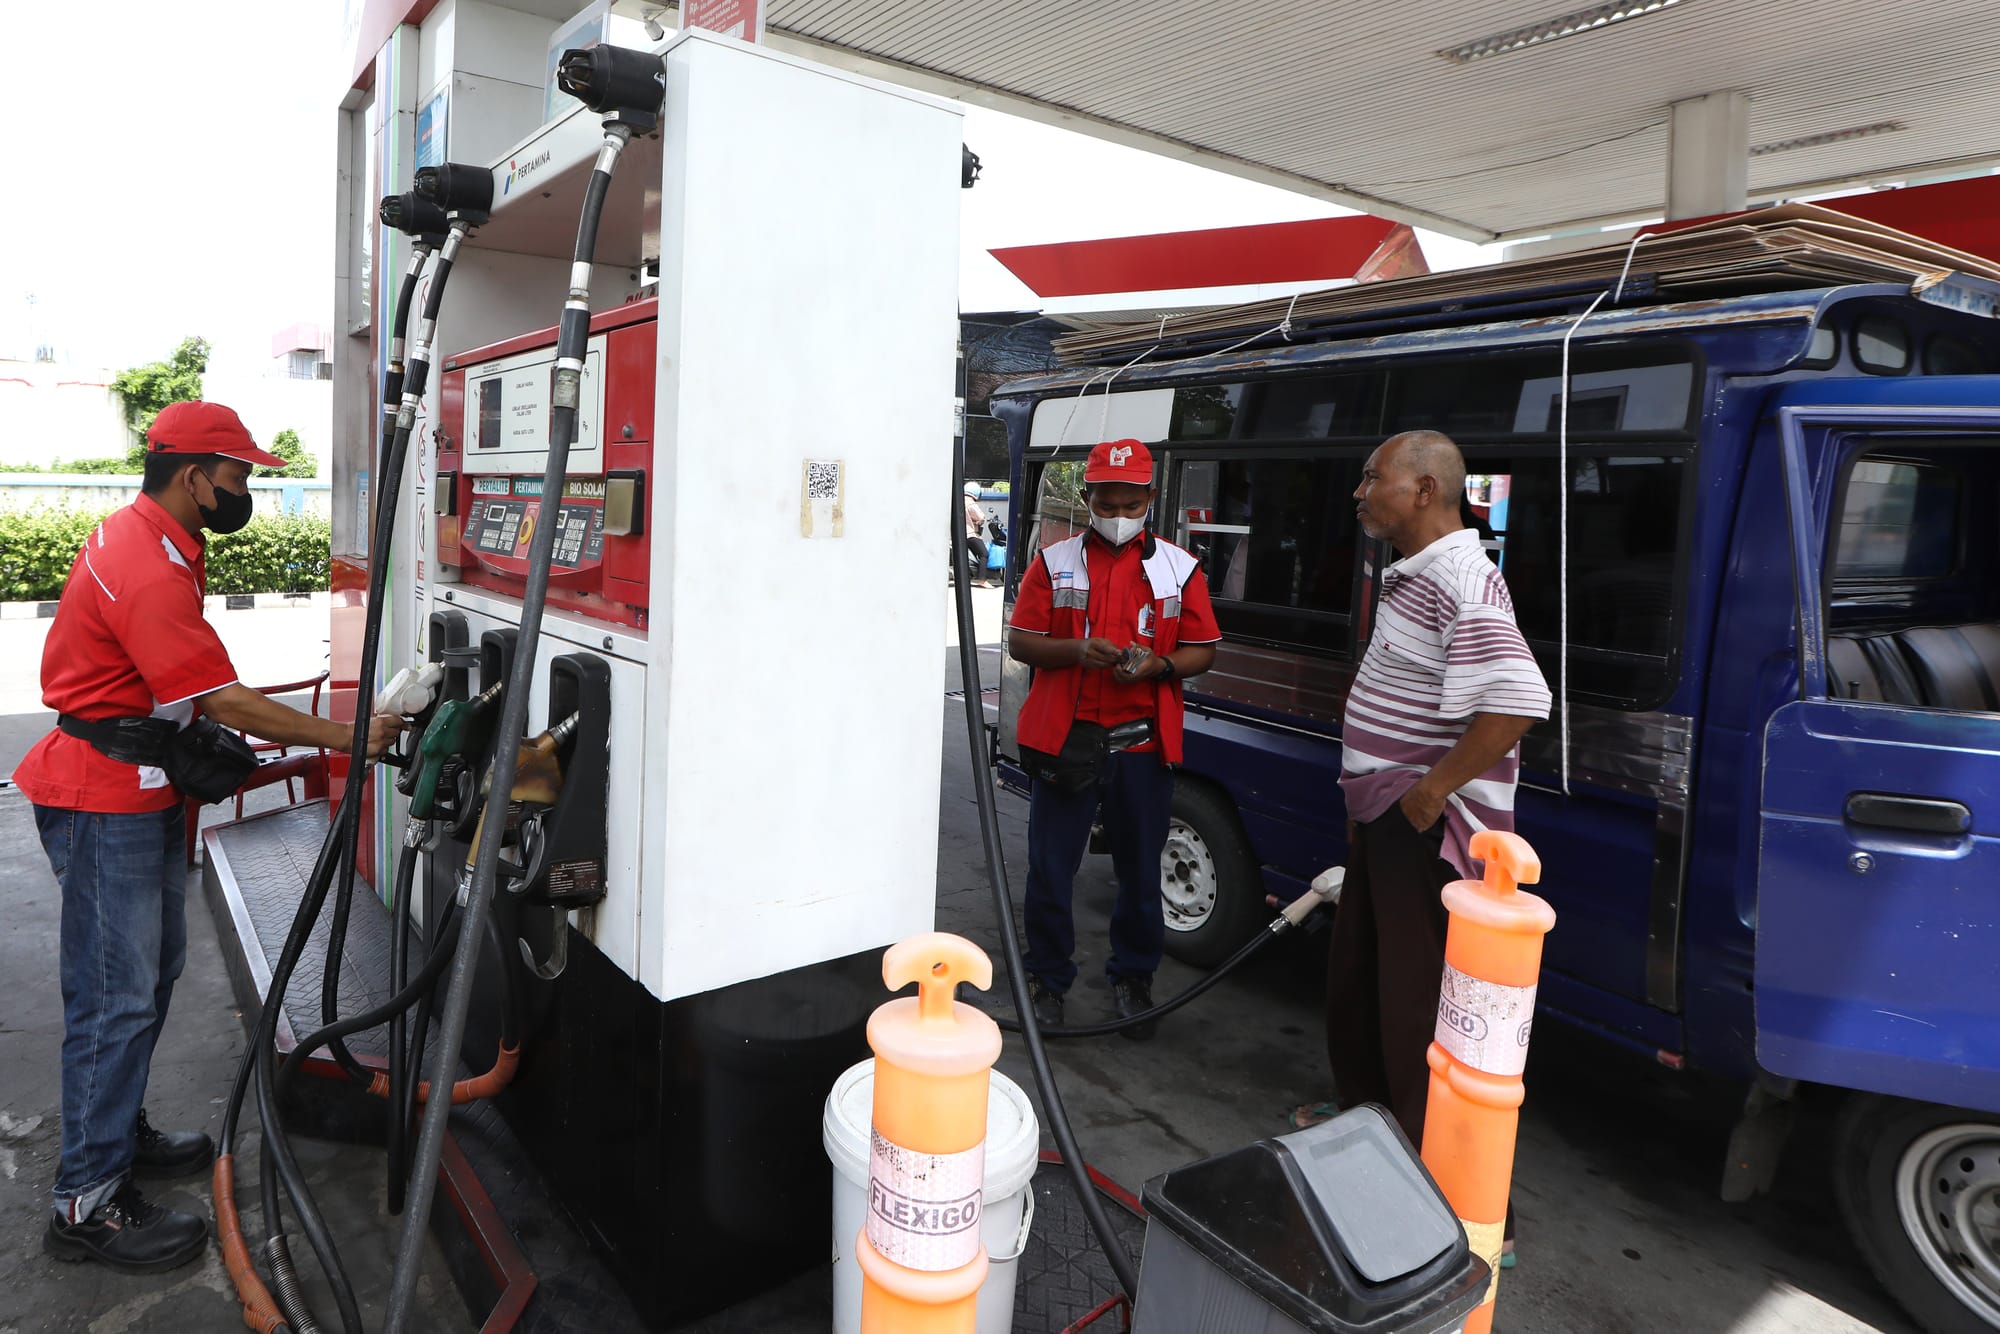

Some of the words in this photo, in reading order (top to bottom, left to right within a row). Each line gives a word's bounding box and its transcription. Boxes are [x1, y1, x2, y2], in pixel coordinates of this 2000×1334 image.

[517, 149, 551, 180] PERTAMINA
[479, 479, 509, 493] PERTALITE
[570, 481, 582, 494] BIO
[872, 1183, 976, 1230] FLEXIGO
